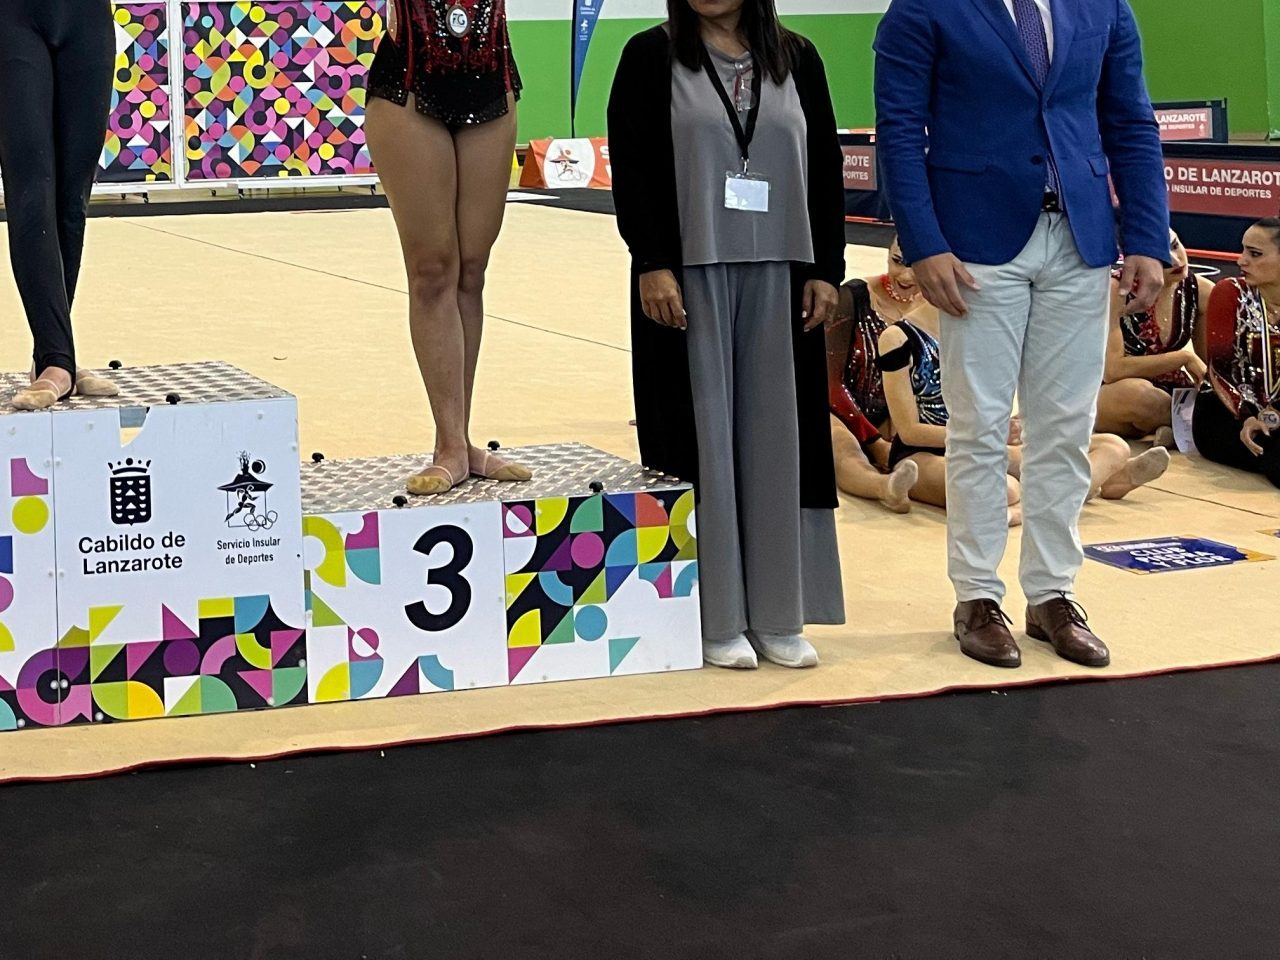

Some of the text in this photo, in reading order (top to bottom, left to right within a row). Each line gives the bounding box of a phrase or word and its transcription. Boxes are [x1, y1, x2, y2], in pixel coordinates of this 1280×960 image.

[1155, 113, 1207, 123] LANZAROTE
[844, 155, 870, 168] ROTE
[1178, 166, 1198, 182] DE
[1171, 184, 1272, 199] INSULAR DE DEPORTES
[78, 531, 186, 555] Cabildo de
[216, 536, 281, 551] Servicio Insular
[82, 553, 184, 576] Lanzarote
[225, 552, 274, 567] de Deportes
[404, 524, 474, 632] 3
